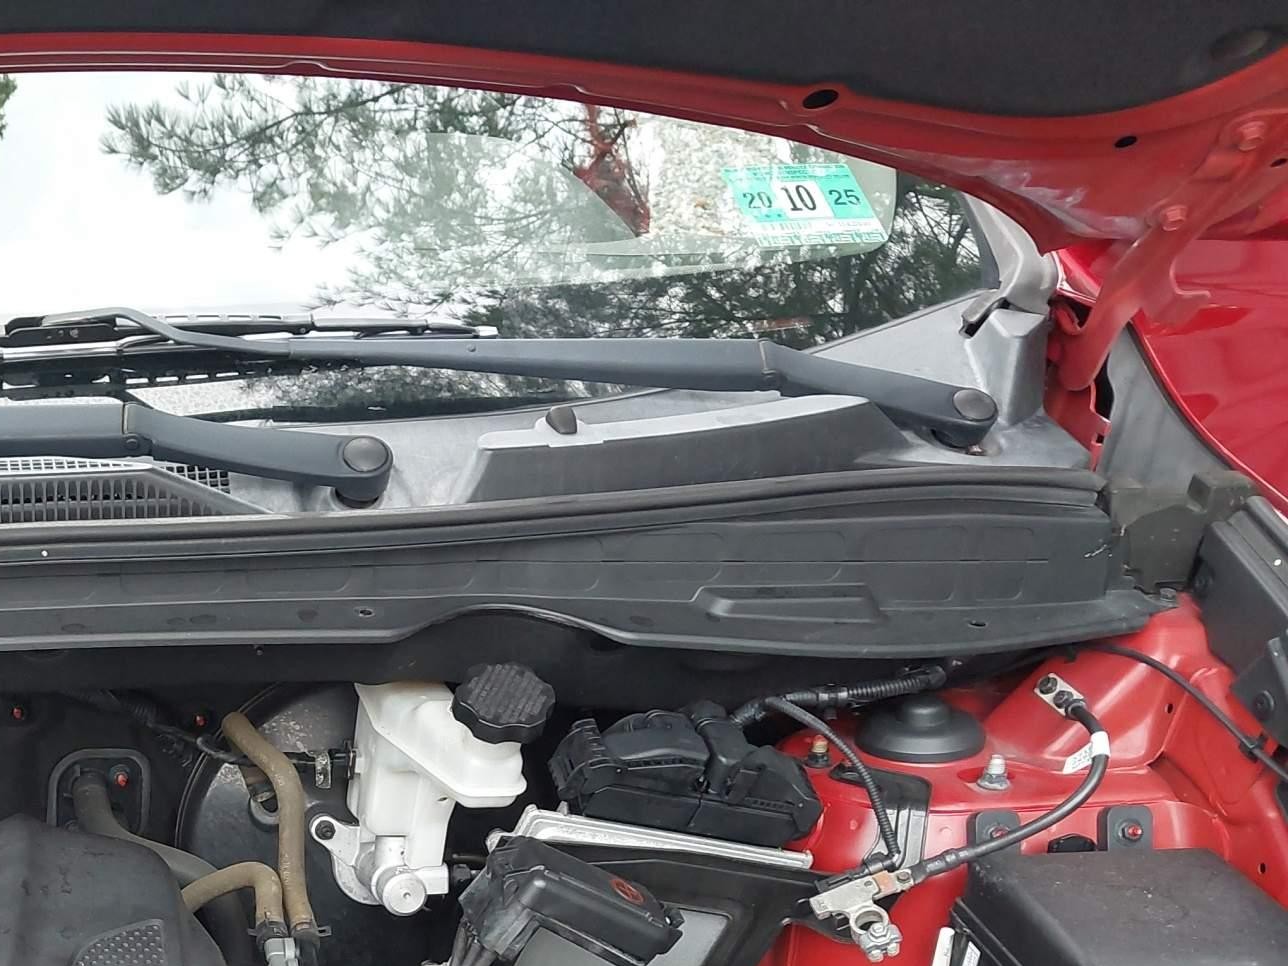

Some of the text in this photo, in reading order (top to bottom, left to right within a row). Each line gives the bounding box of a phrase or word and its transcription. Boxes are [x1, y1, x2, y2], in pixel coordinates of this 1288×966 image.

[743, 184, 861, 211] 20 10 25
